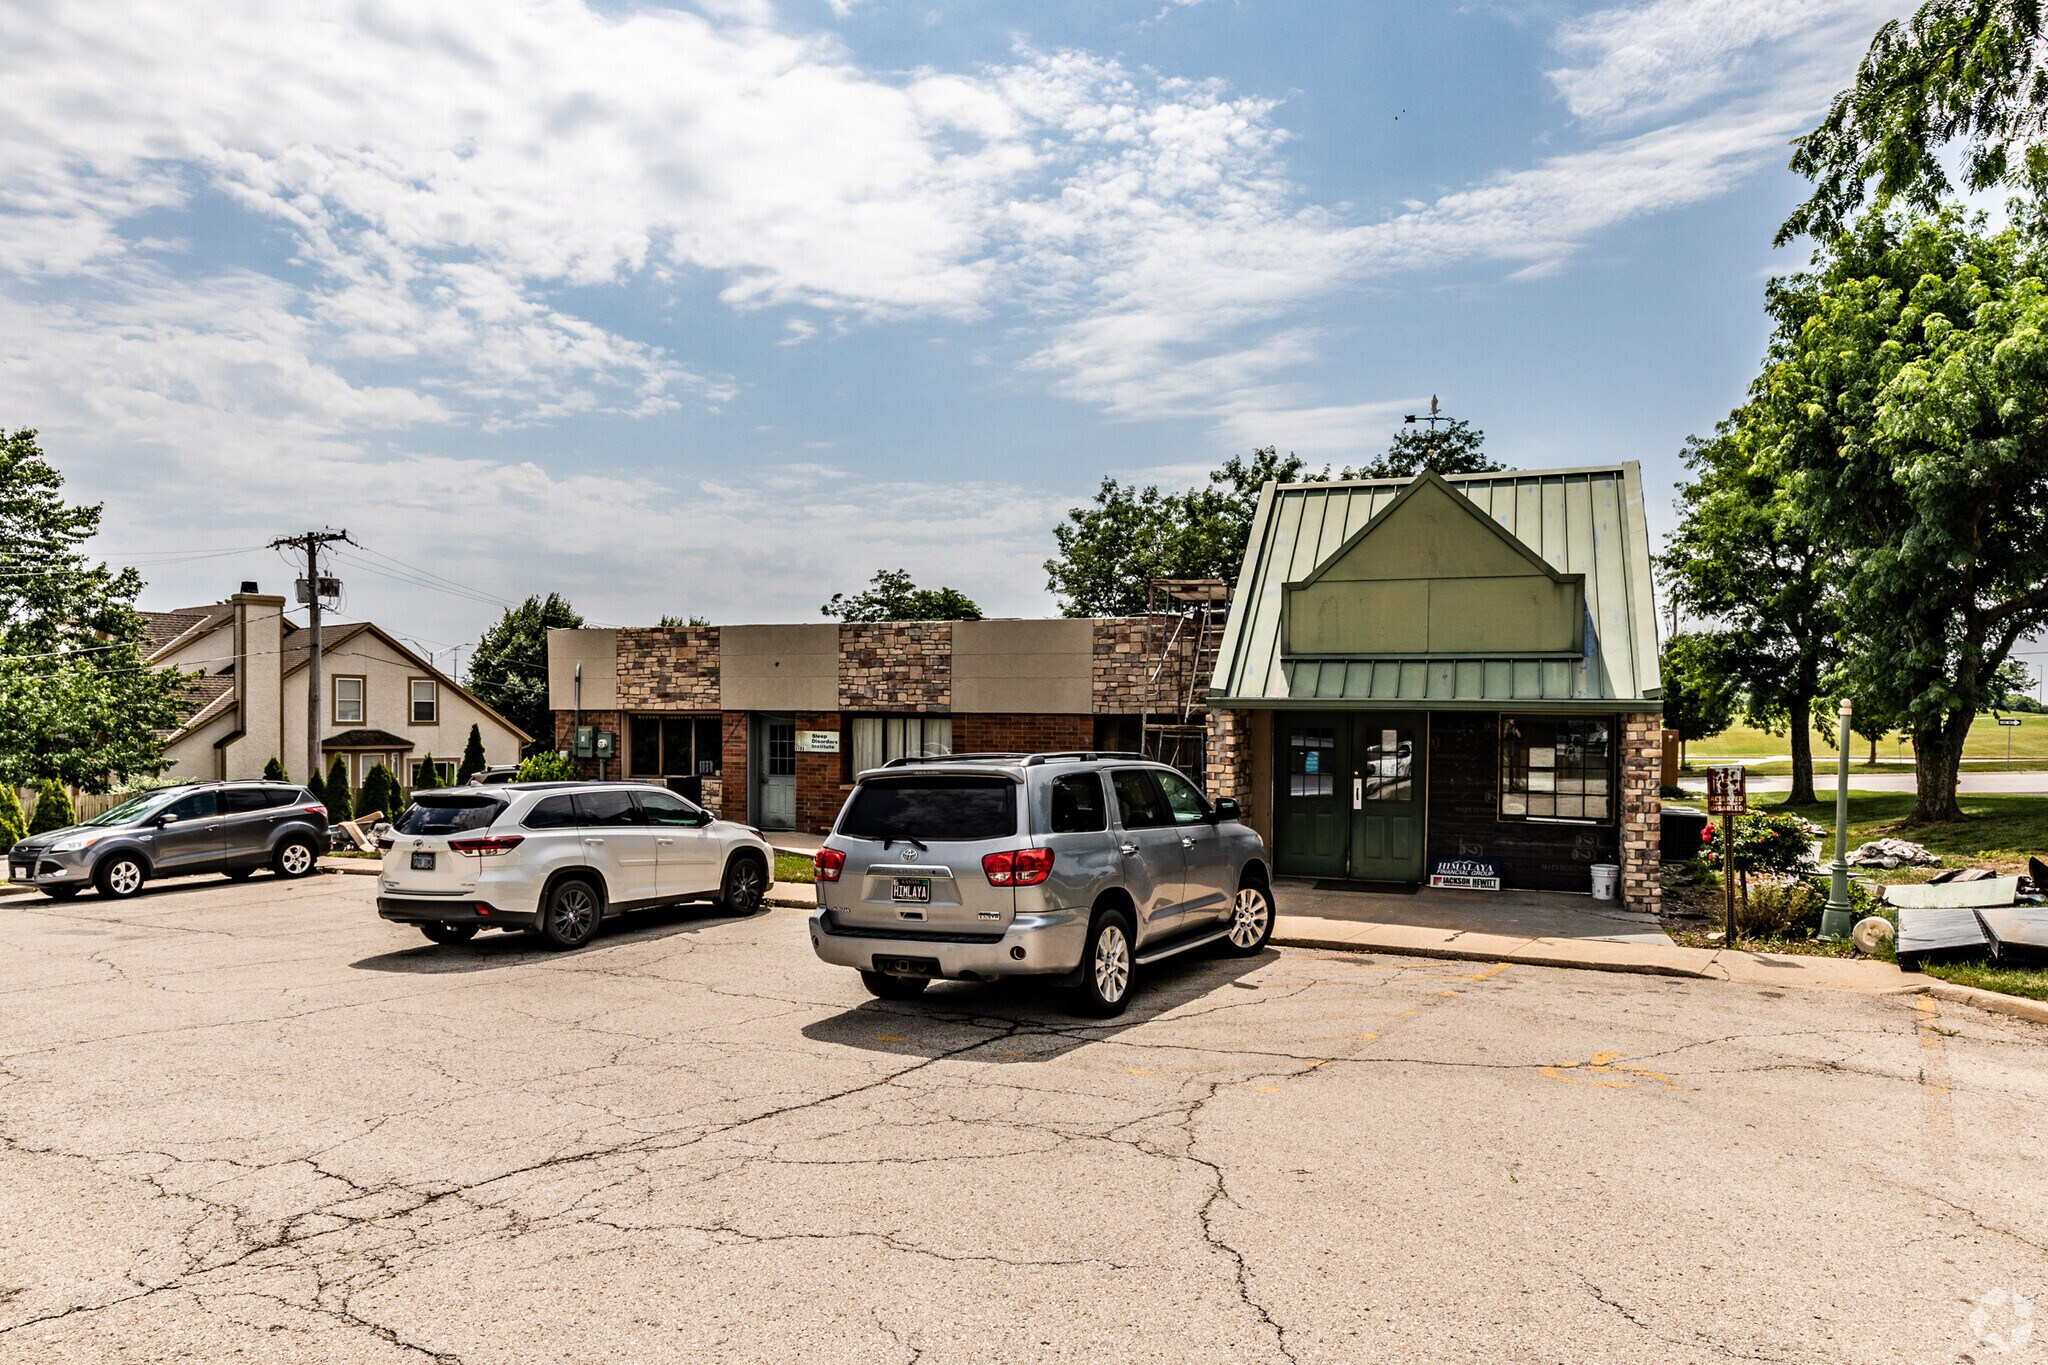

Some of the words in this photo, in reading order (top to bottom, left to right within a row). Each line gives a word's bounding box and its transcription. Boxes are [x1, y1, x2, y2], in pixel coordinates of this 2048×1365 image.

[1438, 862, 1493, 872] HIMALAYA
[1443, 877, 1471, 885] JACKSON
[1472, 878, 1497, 886] HEWITT
[893, 885, 927, 898] HIMLAYA
